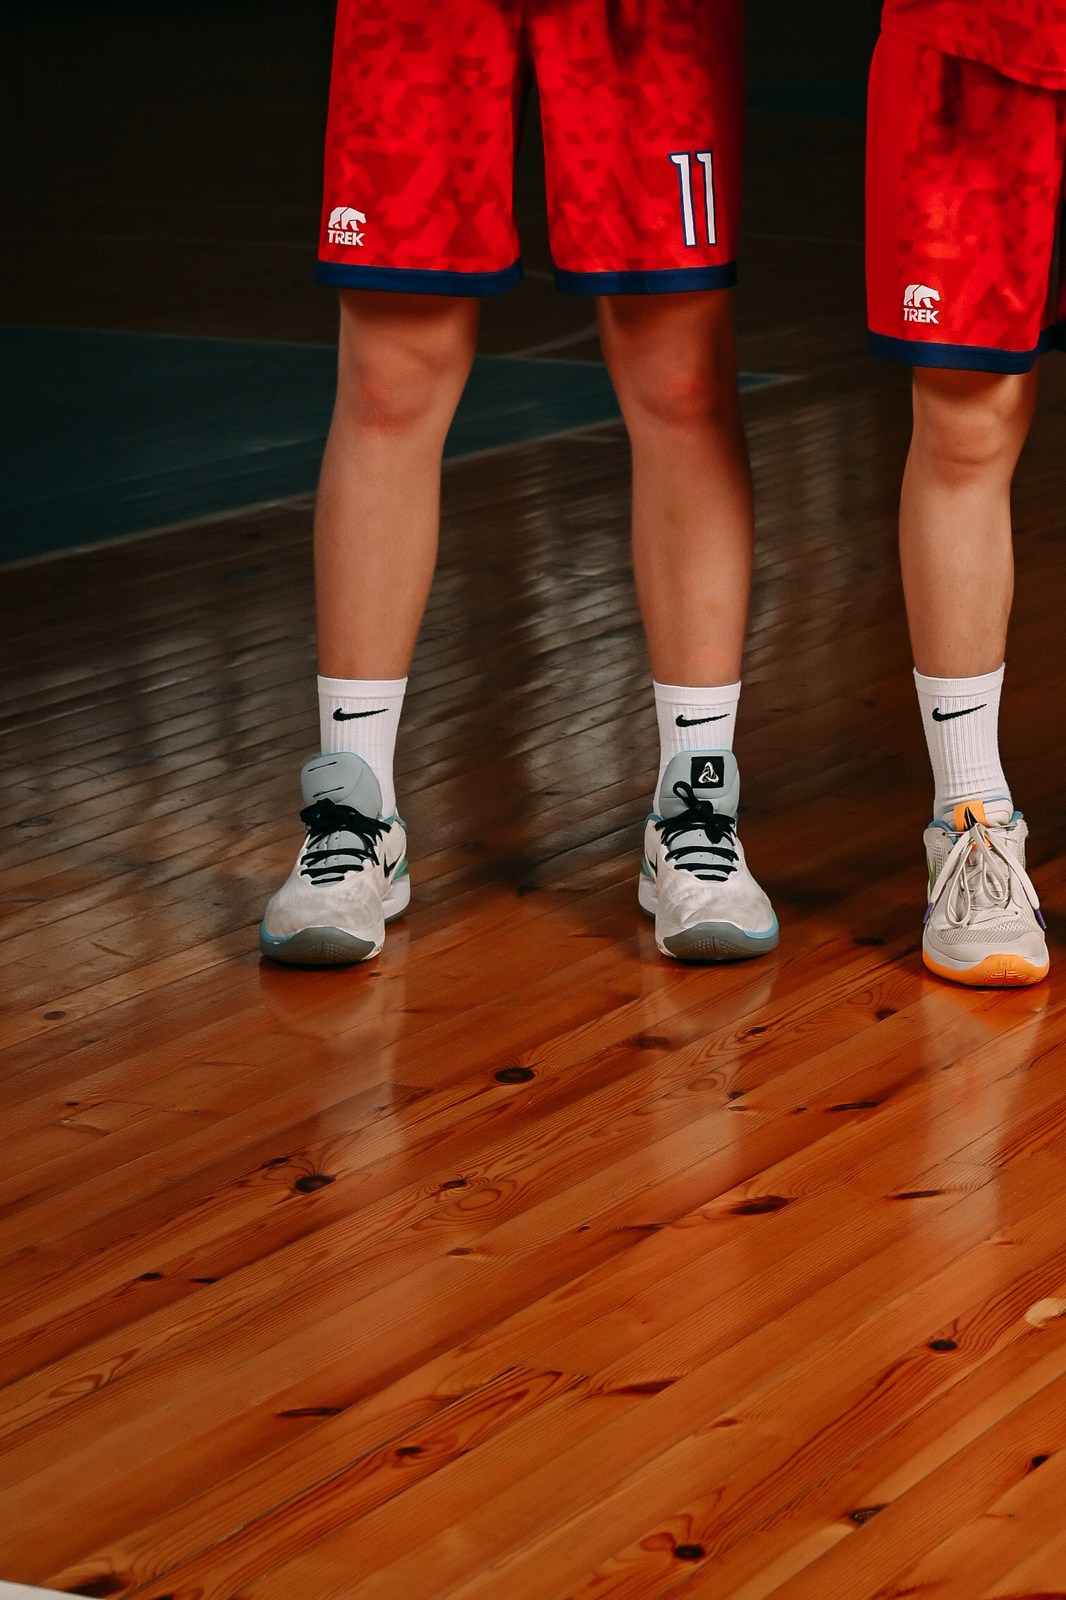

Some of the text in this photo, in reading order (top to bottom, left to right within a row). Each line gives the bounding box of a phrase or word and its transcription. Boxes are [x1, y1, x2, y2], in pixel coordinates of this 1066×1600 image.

[668, 149, 717, 249] 11
[327, 229, 365, 247] TREK
[903, 307, 940, 325] TREK
